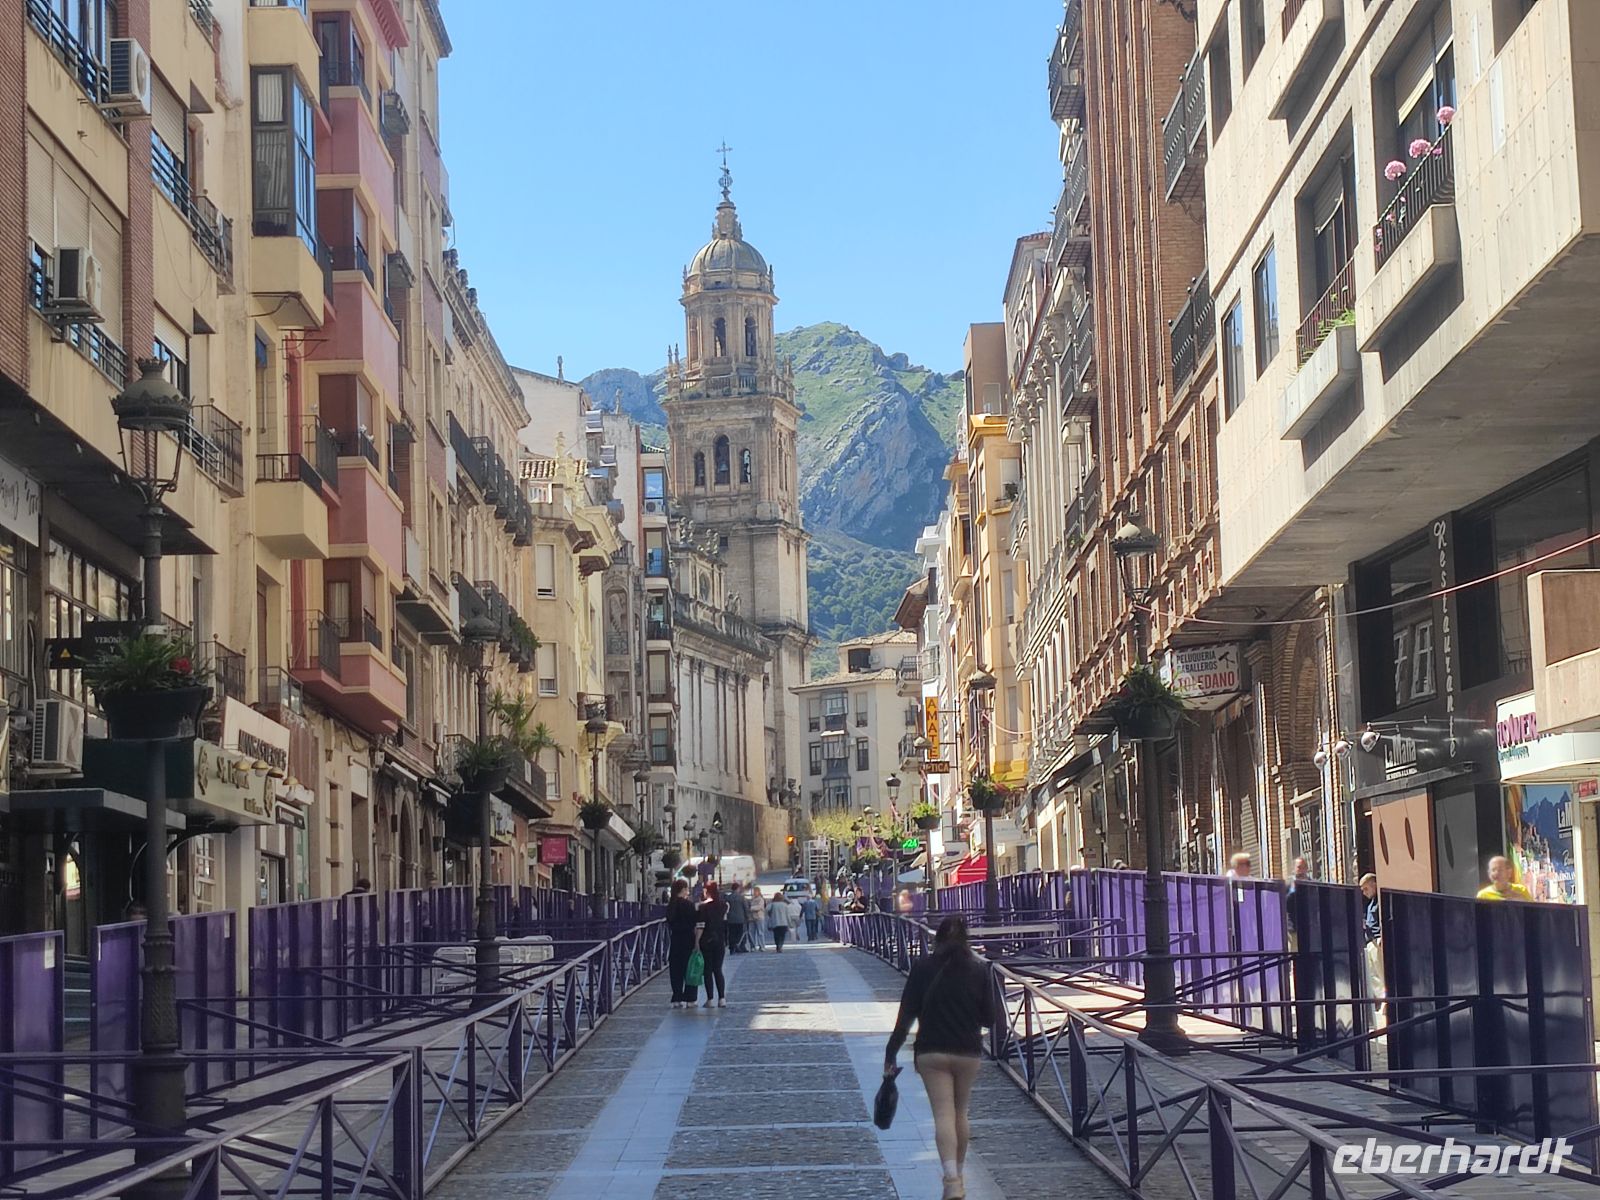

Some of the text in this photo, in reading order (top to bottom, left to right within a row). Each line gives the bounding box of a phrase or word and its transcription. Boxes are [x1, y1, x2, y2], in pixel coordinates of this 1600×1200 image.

[1433, 520, 1457, 759] Restaurante
[1176, 650, 1217, 664] PELUQUERIA
[1178, 671, 1235, 691] TOLEDANO
[927, 698, 939, 758] AMATE
[920, 762, 950, 773] PTICA
